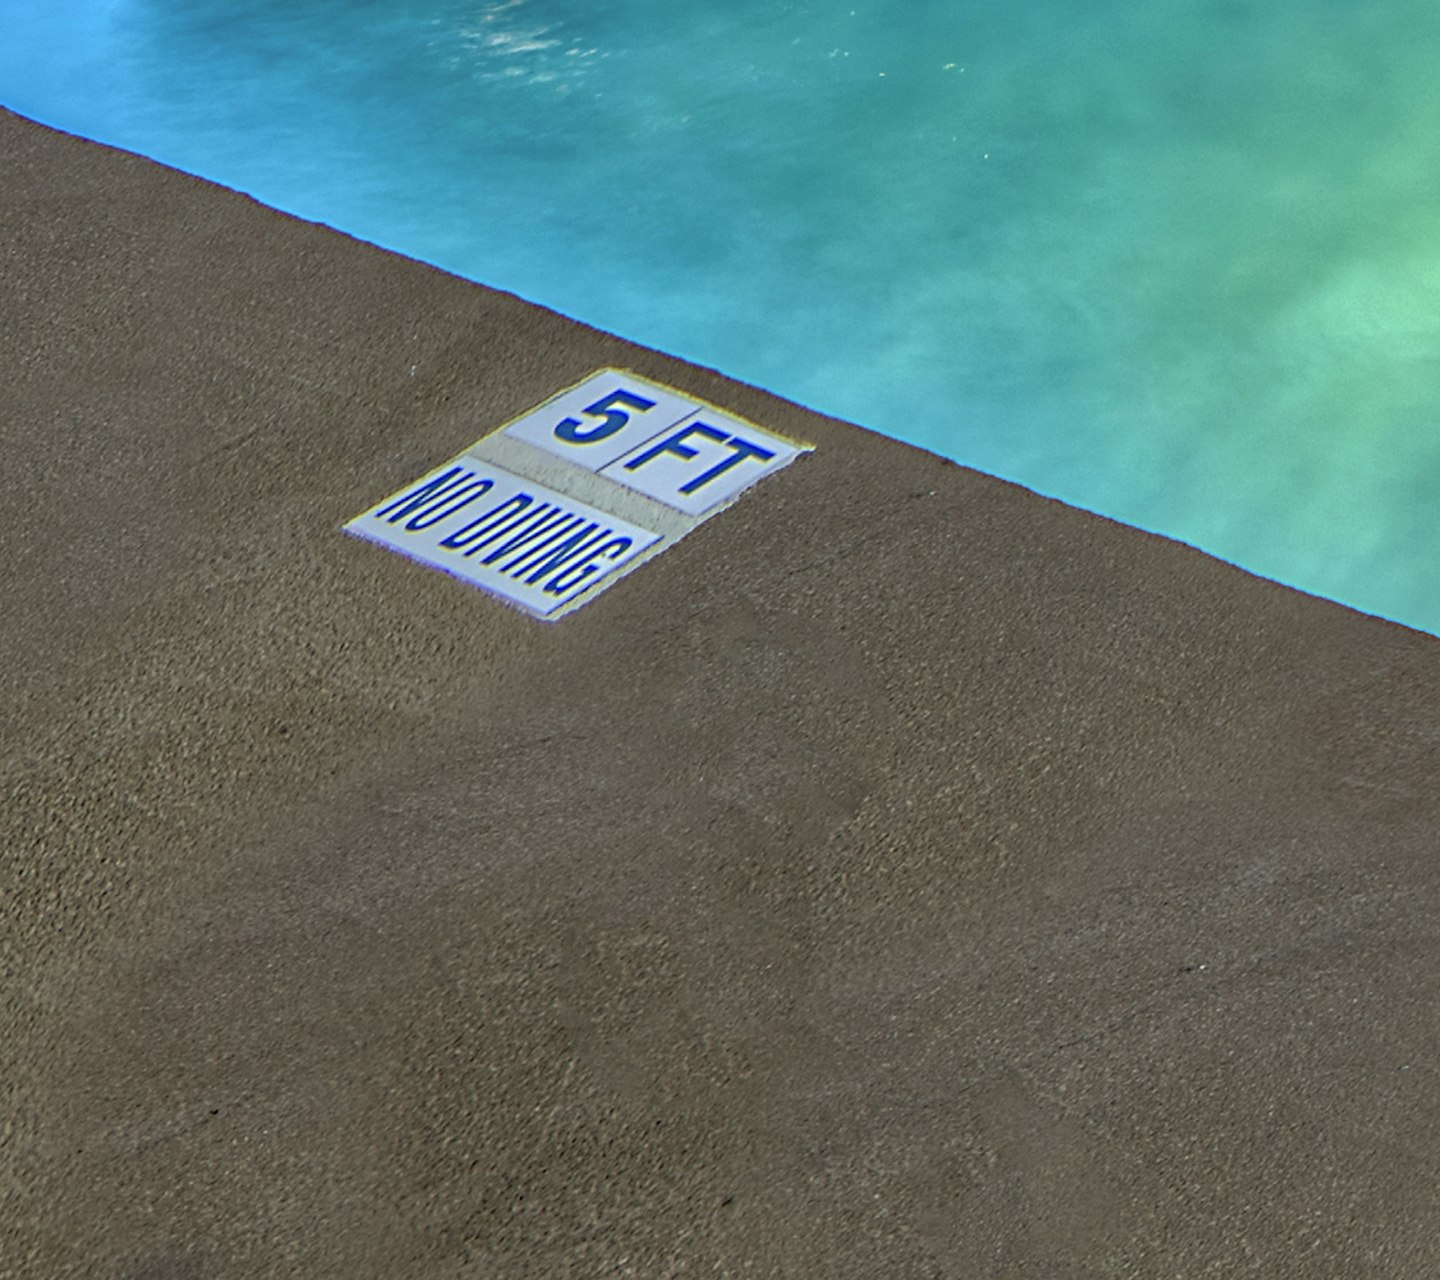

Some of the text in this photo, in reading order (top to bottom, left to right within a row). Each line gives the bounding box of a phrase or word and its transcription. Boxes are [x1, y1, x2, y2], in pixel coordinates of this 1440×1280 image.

[553, 388, 775, 497] 5 FT
[375, 466, 634, 598] NO DIVING
